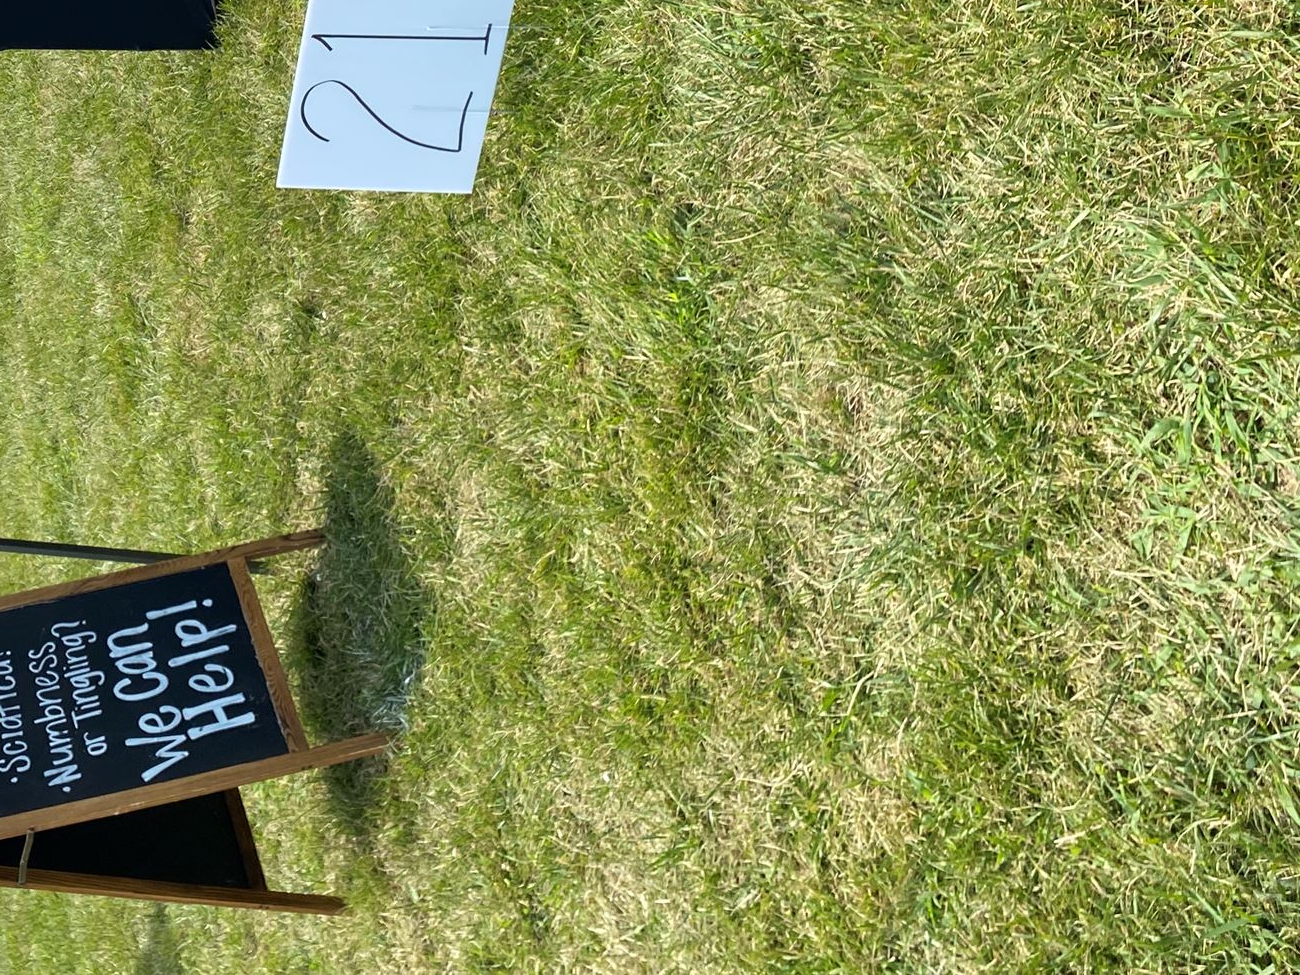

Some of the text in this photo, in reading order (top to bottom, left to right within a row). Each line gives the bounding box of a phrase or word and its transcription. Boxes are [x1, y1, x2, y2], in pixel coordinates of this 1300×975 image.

[300, 23, 492, 152] 21
[28, 642, 81, 786] Numbness
[52, 621, 107, 756] or Tingling?
[107, 623, 189, 783] We Can
[145, 599, 255, 740] Help!
